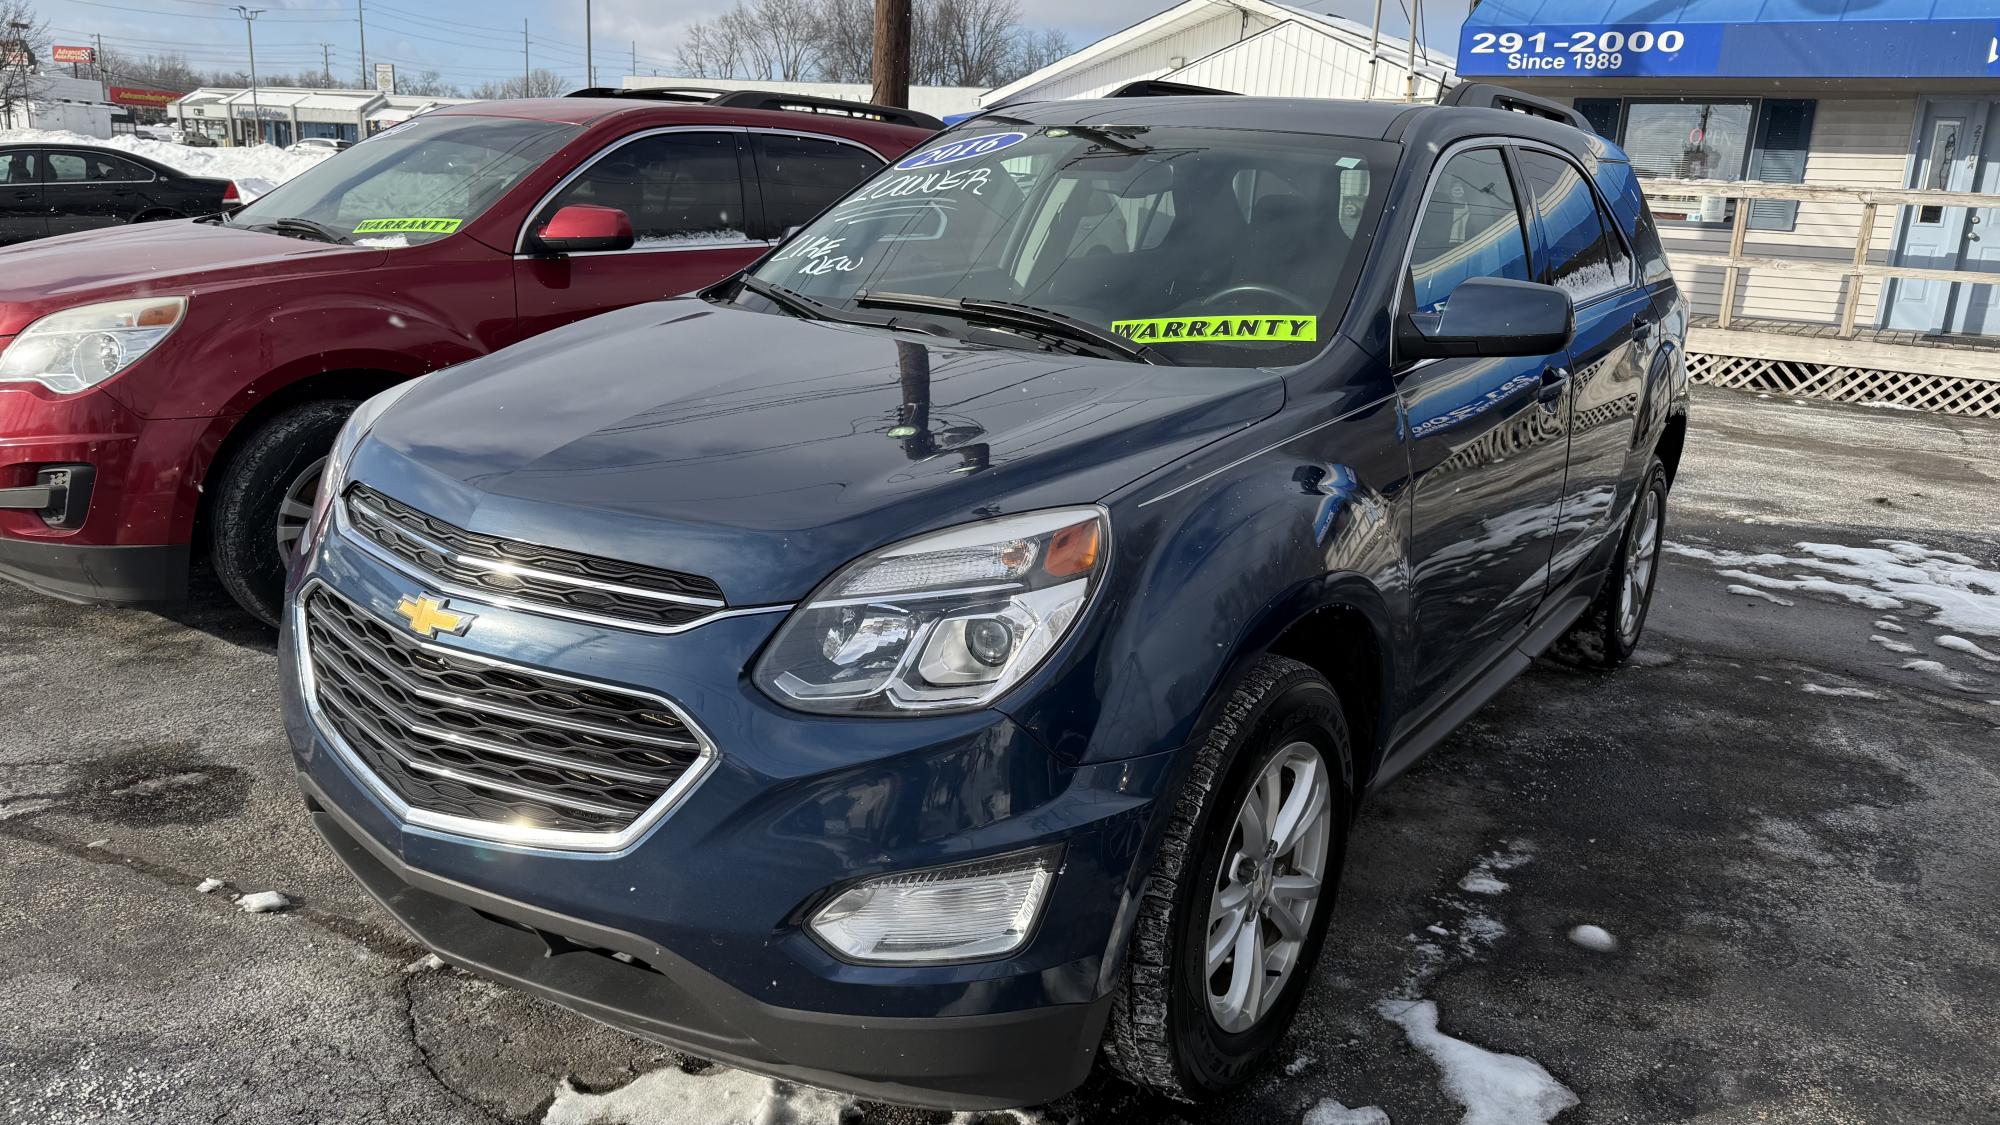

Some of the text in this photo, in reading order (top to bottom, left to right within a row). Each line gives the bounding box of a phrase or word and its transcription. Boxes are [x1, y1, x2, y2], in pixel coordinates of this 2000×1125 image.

[1470, 31, 1684, 54] 291-2000
[1507, 53, 1623, 70] Since 1989
[1689, 128, 1732, 146] OPEN
[911, 134, 1008, 168] 2016
[358, 220, 457, 231] WARRANTY
[770, 235, 846, 262] LIKE
[798, 256, 863, 275] NEW
[1114, 319, 1312, 340] WARRANTY
